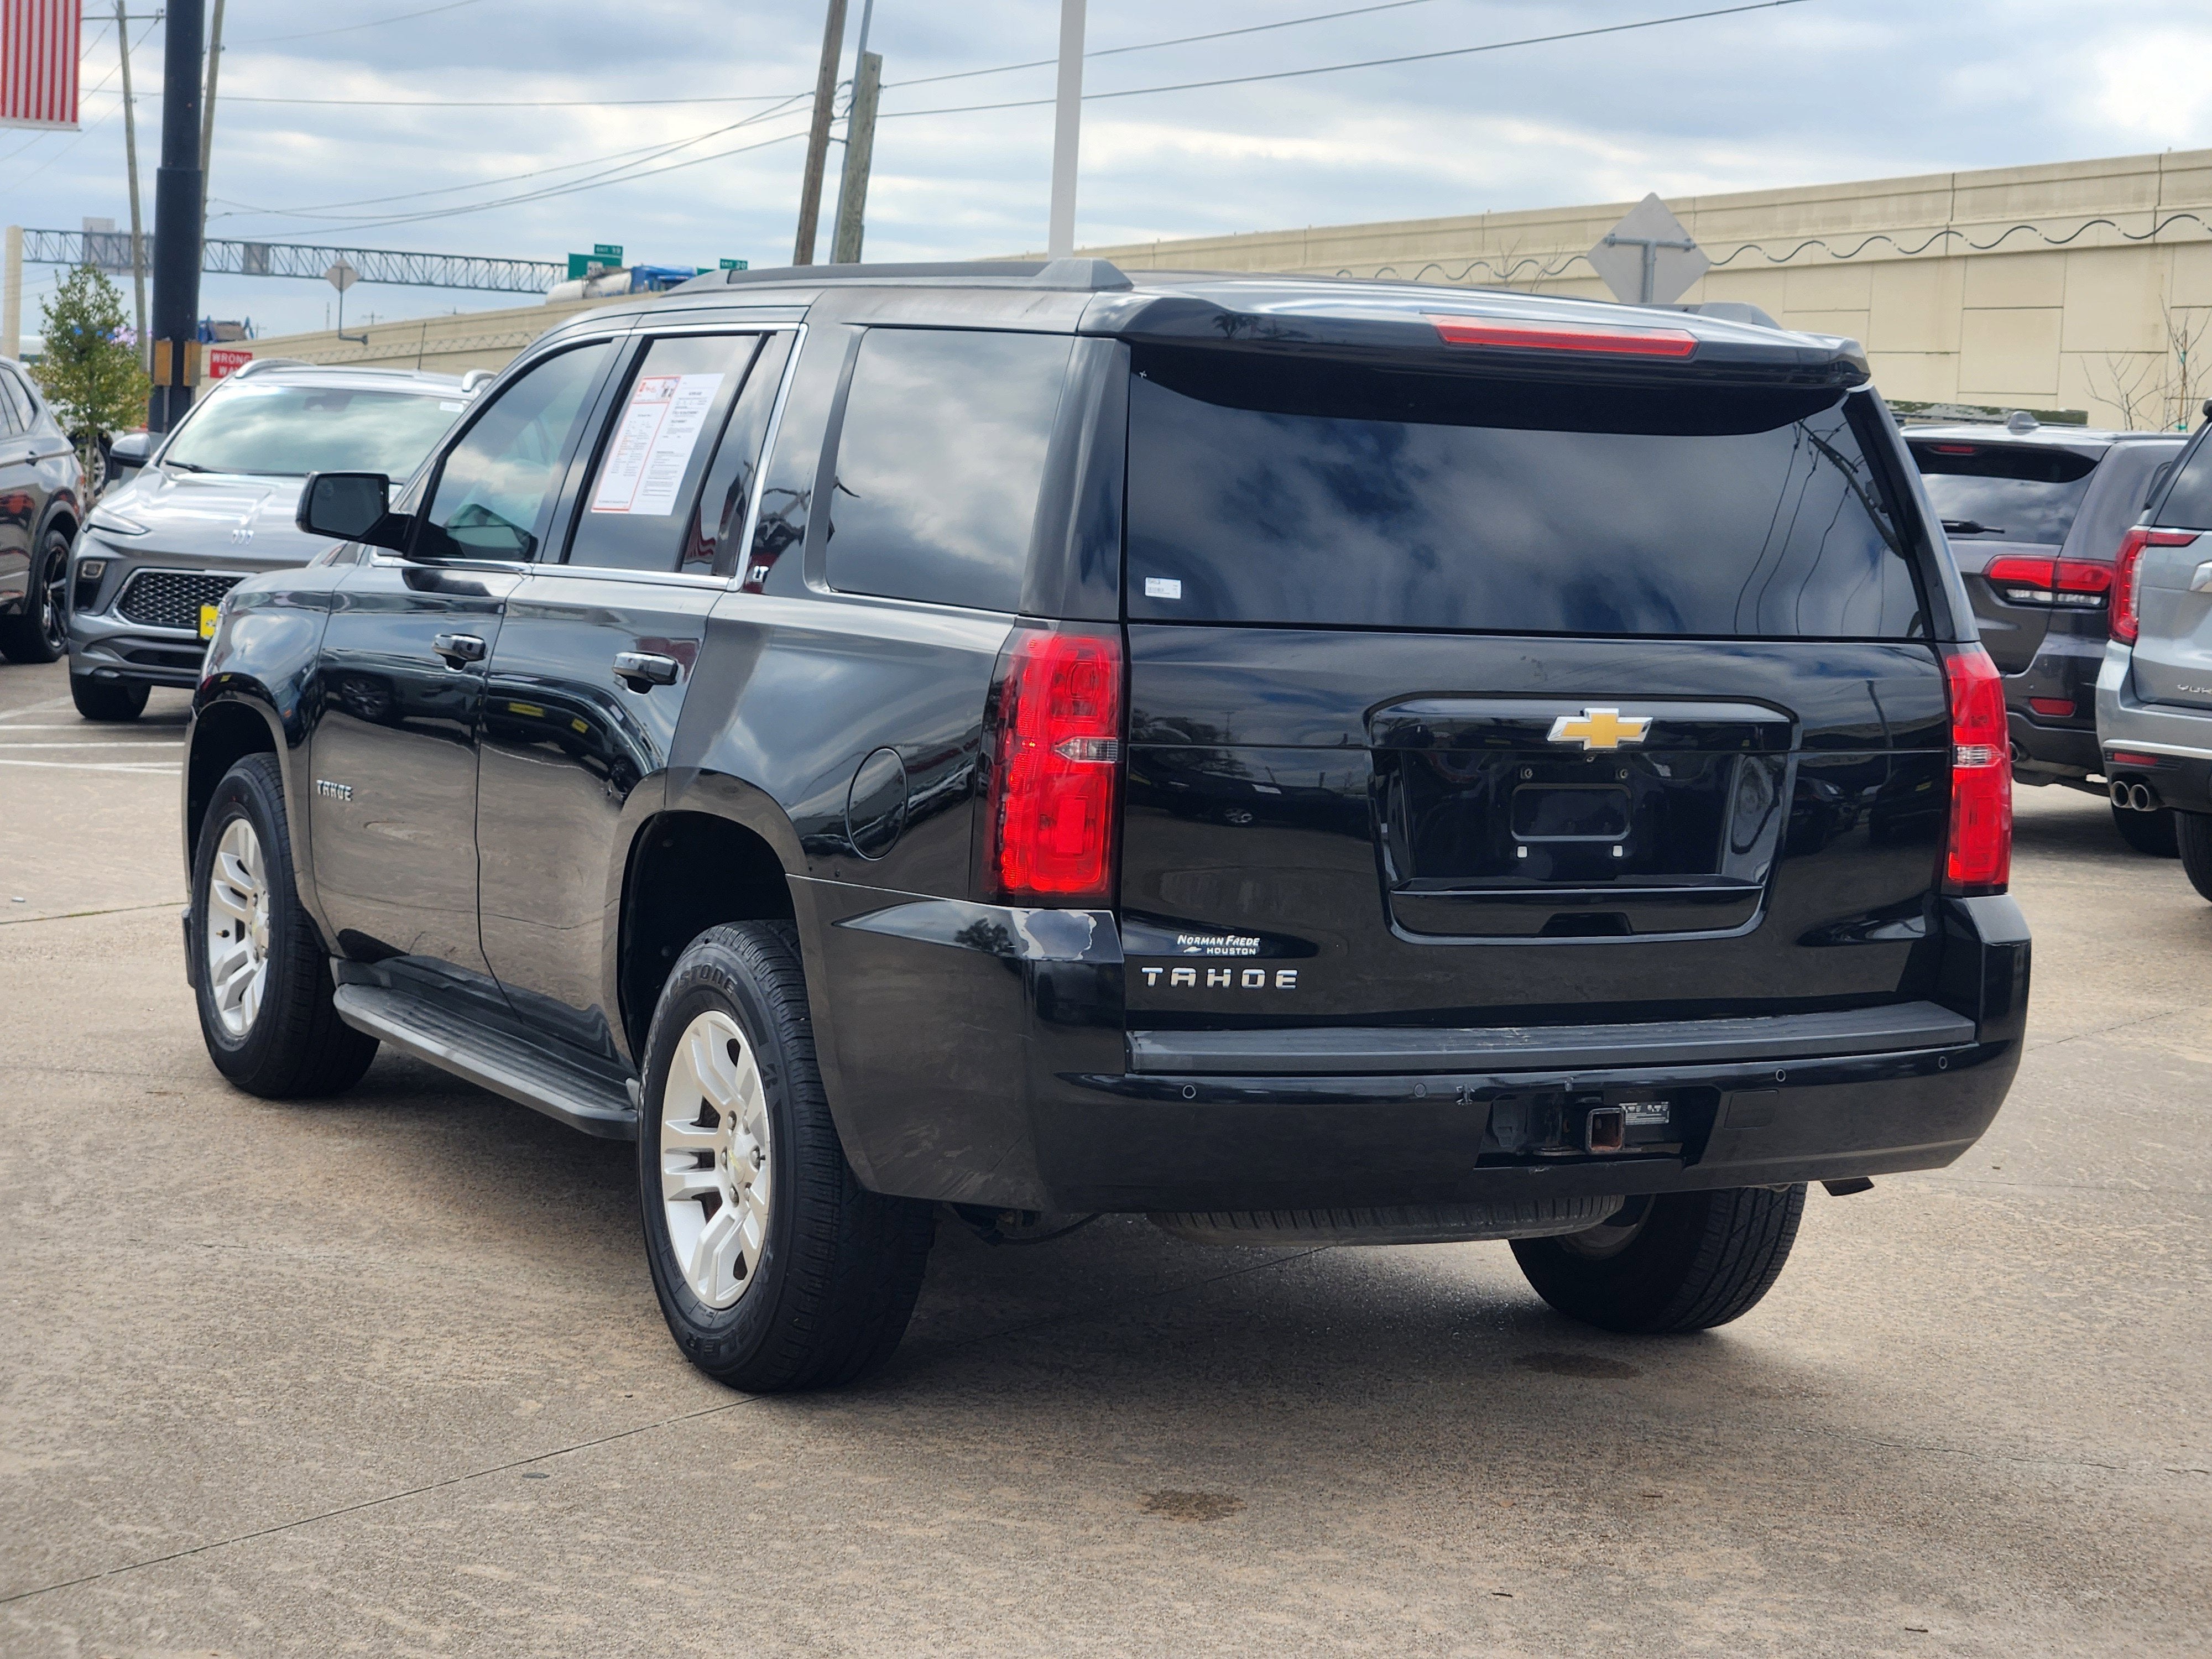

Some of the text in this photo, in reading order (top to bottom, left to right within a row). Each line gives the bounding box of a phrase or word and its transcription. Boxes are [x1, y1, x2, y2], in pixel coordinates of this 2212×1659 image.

[316, 780, 352, 801] TAHOE
[1177, 934, 1261, 947] NORMAN FREDE
[1206, 947, 1256, 956] HOUSTON
[1141, 967, 1298, 989] TAHOE
